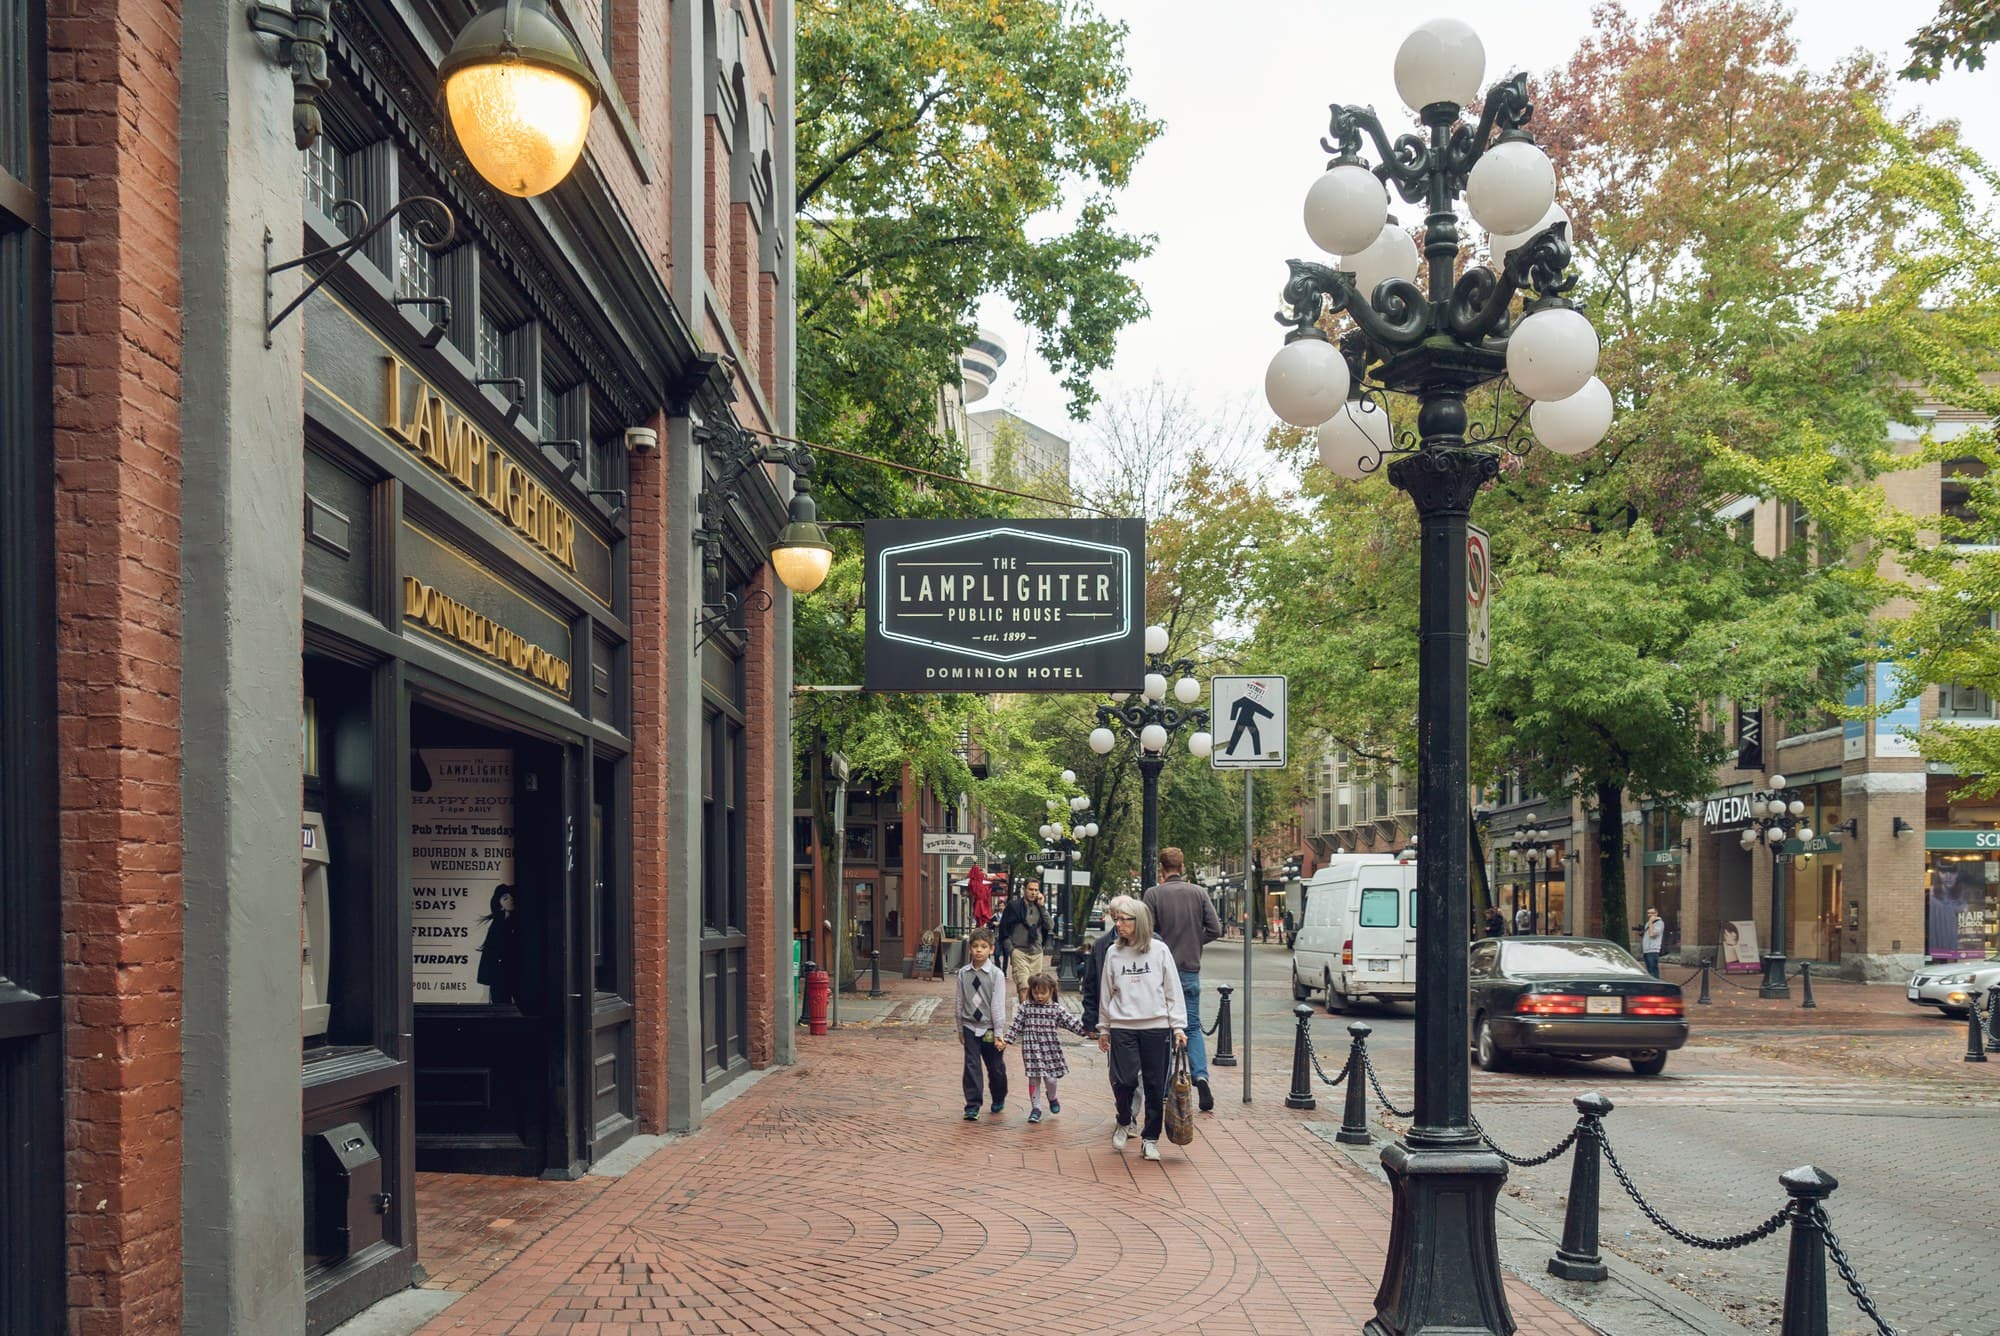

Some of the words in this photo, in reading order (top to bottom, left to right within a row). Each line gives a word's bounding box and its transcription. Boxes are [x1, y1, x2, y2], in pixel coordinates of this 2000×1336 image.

[385, 356, 577, 572] LAMPLIGHTER
[993, 557, 1017, 570] THE
[900, 575, 1110, 602] LAMPLIGHTER
[948, 607, 1003, 622] PUBLIC
[1012, 607, 1062, 622] HOUSE
[404, 576, 499, 656] DONNELLY
[497, 627, 528, 671] PUB
[527, 644, 569, 691] GROUP
[983, 633, 999, 642] est.
[1002, 632, 1026, 642] 1899
[926, 667, 1018, 679] DOMINION
[1027, 667, 1083, 679] HOTEL
[412, 796, 469, 805] HAPPY
[1704, 795, 1751, 826] AVEDA
[411, 824, 432, 835] Pub
[435, 824, 468, 835] Trivia
[1803, 839, 1828, 851] AVEDA
[412, 847, 466, 858] BOURBON
[471, 848, 479, 858] &
[430, 860, 501, 871] WEDNESDAY
[442, 887, 469, 897] LIVE
[1957, 911, 1985, 922] HAIR
[440, 982, 467, 991] GAMES
